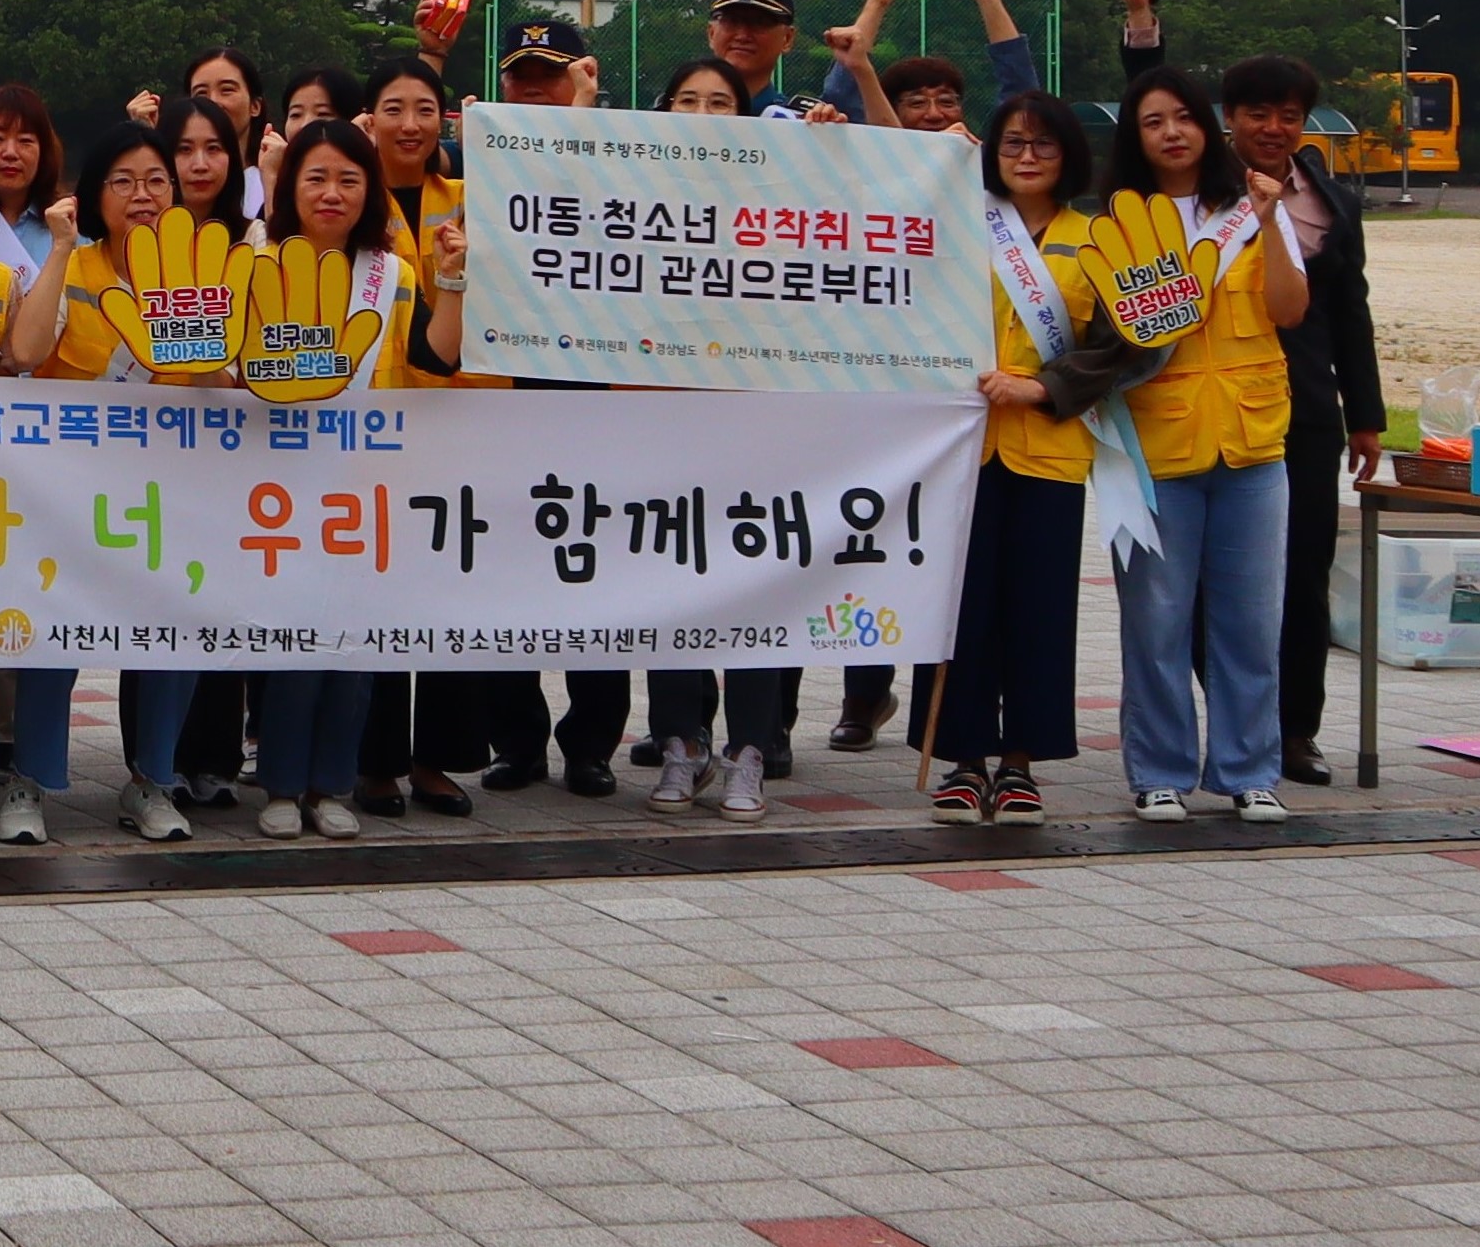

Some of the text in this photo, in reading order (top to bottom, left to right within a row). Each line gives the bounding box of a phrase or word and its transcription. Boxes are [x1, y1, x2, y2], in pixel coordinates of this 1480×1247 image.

[486, 134, 545, 152] 2023년
[550, 138, 596, 157] 성매매
[733, 205, 849, 252] 성착취
[863, 213, 936, 257] 근절
[531, 248, 913, 307] 우리의 관심으로부터!
[1114, 251, 1181, 292] 나와 너
[141, 287, 232, 319] 고운말
[1115, 275, 1202, 324] 입장바꿔
[262, 324, 332, 350] 친구에게
[1134, 303, 1200, 341] 생각하기
[151, 340, 226, 363] 밝아져요
[500, 332, 549, 348] 여성가족부
[655, 343, 697, 356] 경상남도
[247, 358, 292, 380] 따뜻한
[269, 408, 403, 452] 캠페인
[240, 481, 489, 577] 우리가
[46, 624, 121, 652] 사천시
[363, 627, 435, 654] 사천시
[444, 627, 658, 654] 청소년상담복지센터
[672, 626, 789, 651] 832-7942
